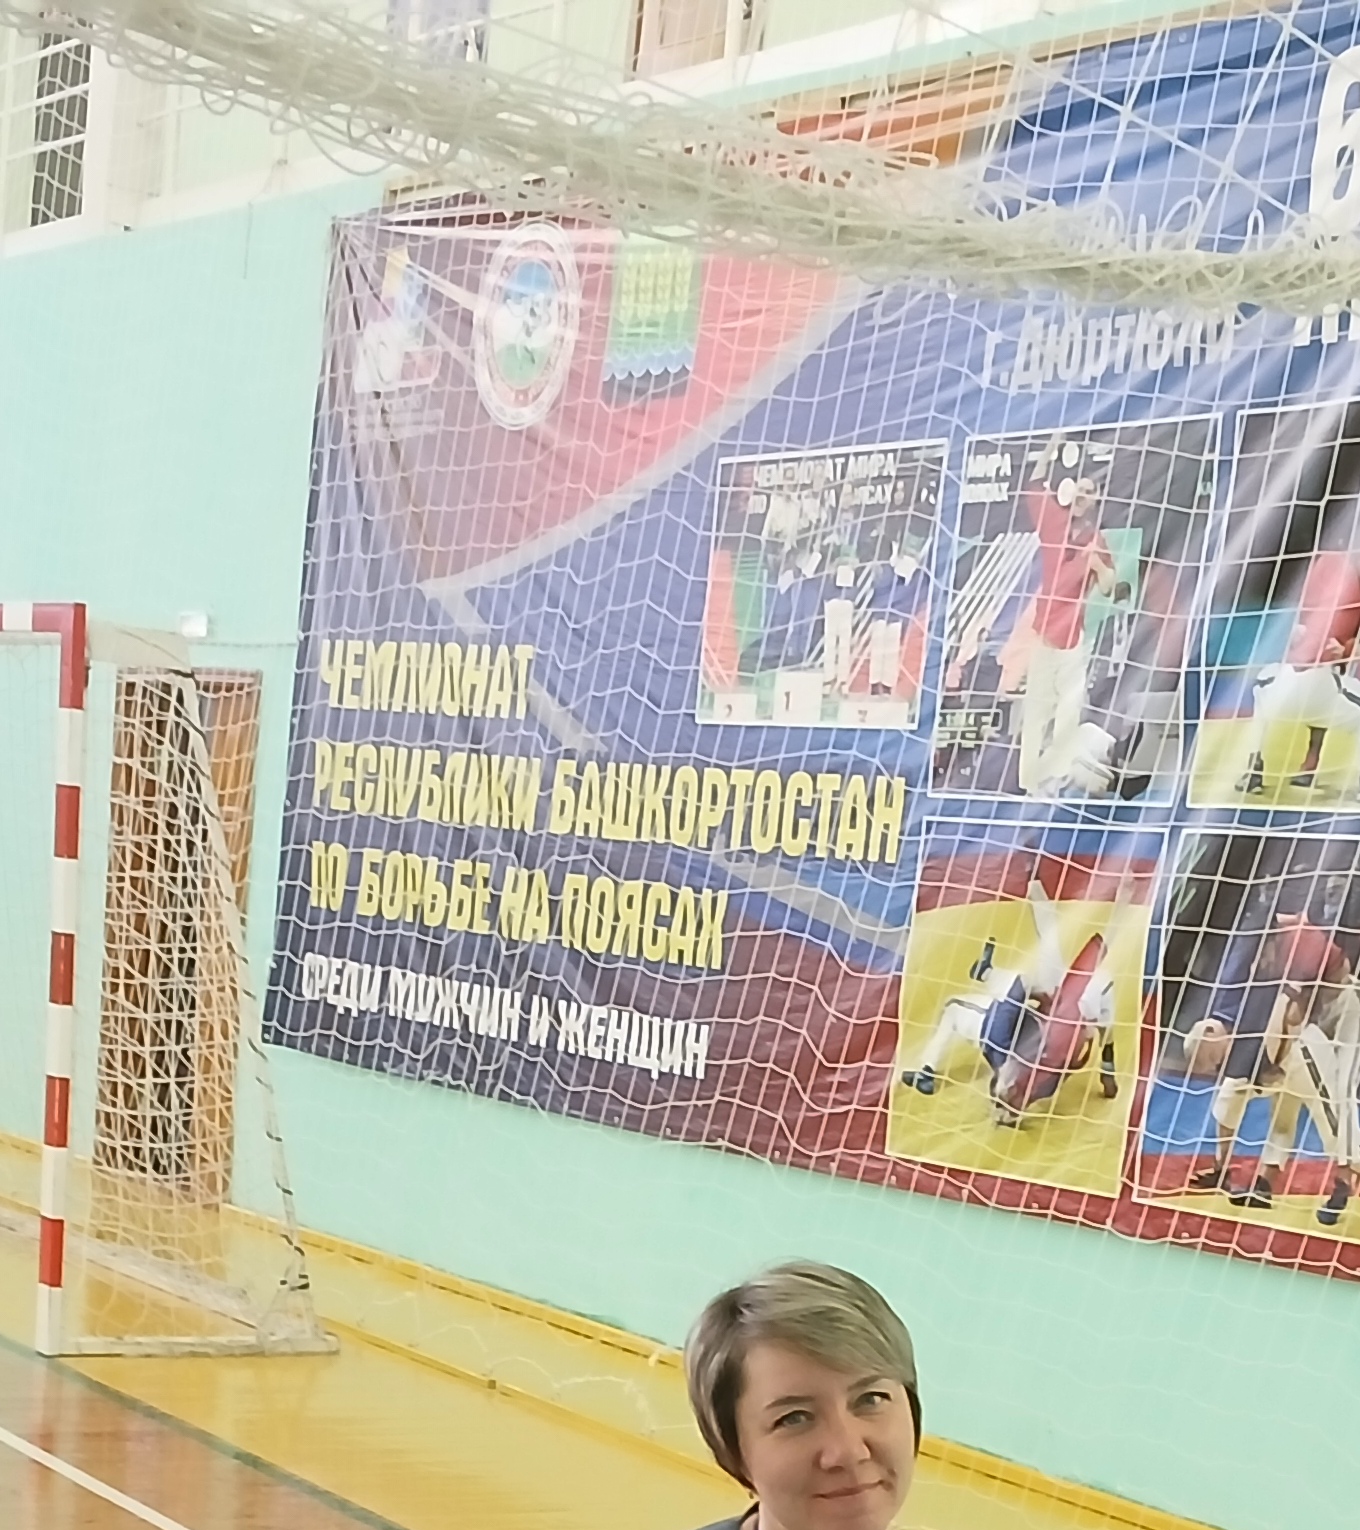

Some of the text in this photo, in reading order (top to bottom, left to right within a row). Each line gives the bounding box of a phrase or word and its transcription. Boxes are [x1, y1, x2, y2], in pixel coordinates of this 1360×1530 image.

[320, 638, 534, 720] ЧЕМПИОНАТ
[313, 740, 906, 864] РЕСПУБЛИКИ БАШКОРТОСТАН
[309, 840, 728, 970] ПО БОРЬБЕ НА ПОЯСАХ
[301, 952, 383, 1018] СРЕДИ
[388, 969, 522, 1042] МУЖЧИН
[557, 999, 711, 1080] ЖЕНЩИН
